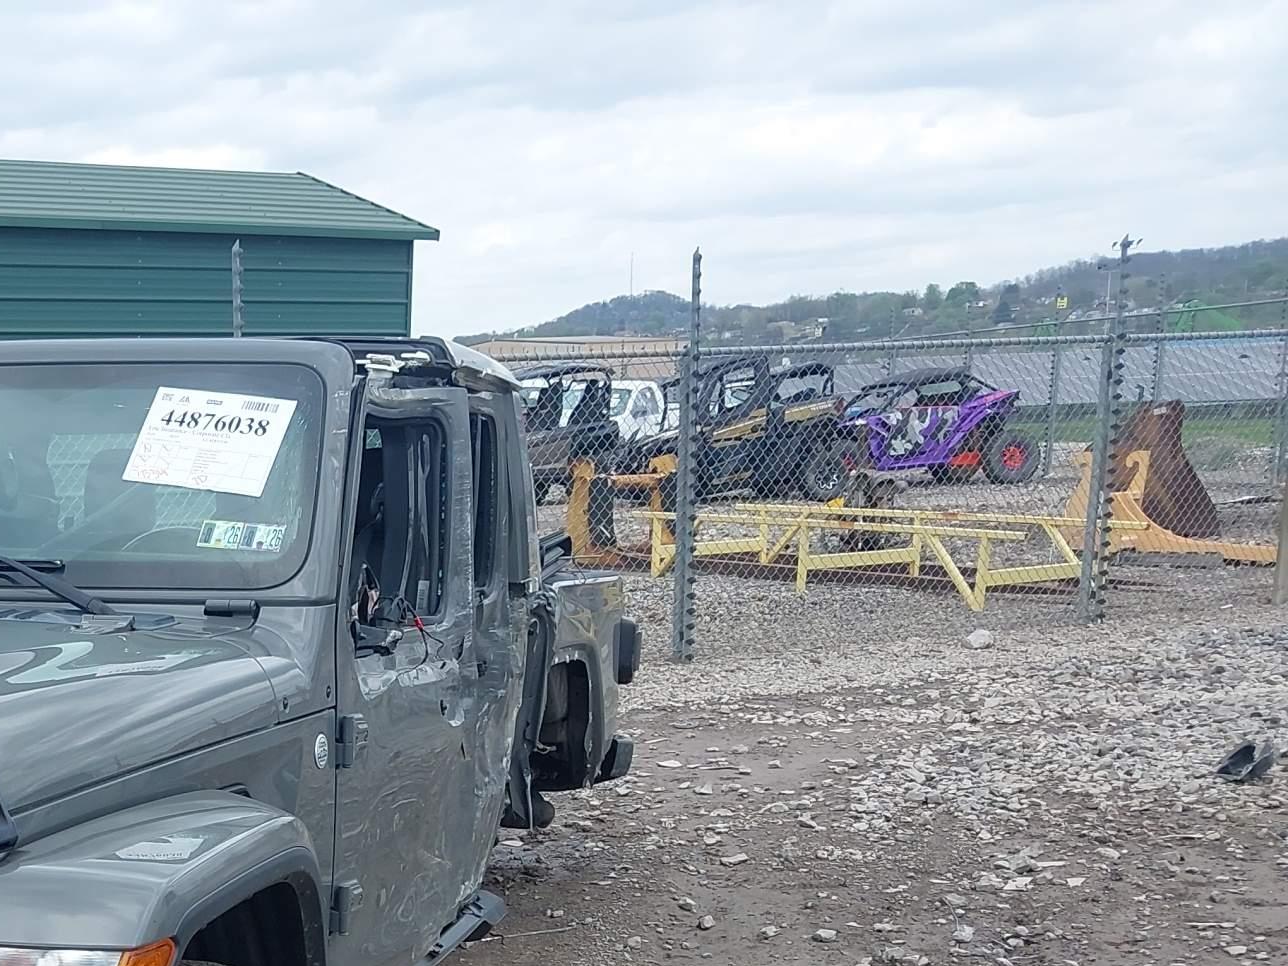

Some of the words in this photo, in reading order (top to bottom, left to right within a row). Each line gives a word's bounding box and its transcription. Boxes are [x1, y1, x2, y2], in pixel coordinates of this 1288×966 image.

[161, 409, 270, 437] 44876038
[227, 526, 241, 544] 26
[269, 529, 283, 547] 26
